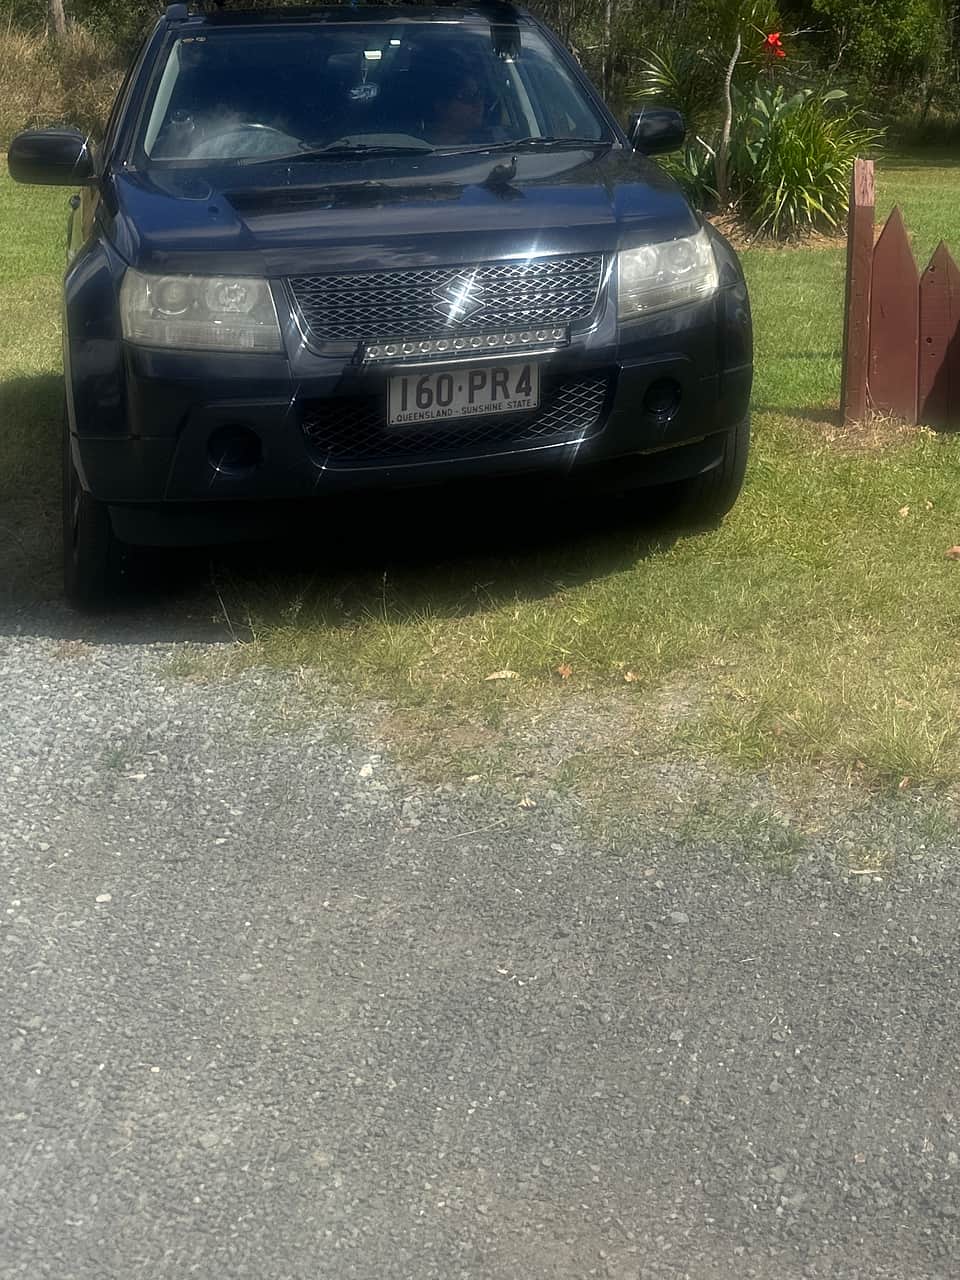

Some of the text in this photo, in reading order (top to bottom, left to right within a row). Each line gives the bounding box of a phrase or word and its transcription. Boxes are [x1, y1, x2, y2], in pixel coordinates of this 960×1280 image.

[397, 408, 453, 422] QUEENSLAND
[461, 402, 502, 414] SUNSHINE
[507, 398, 532, 409] STATE
